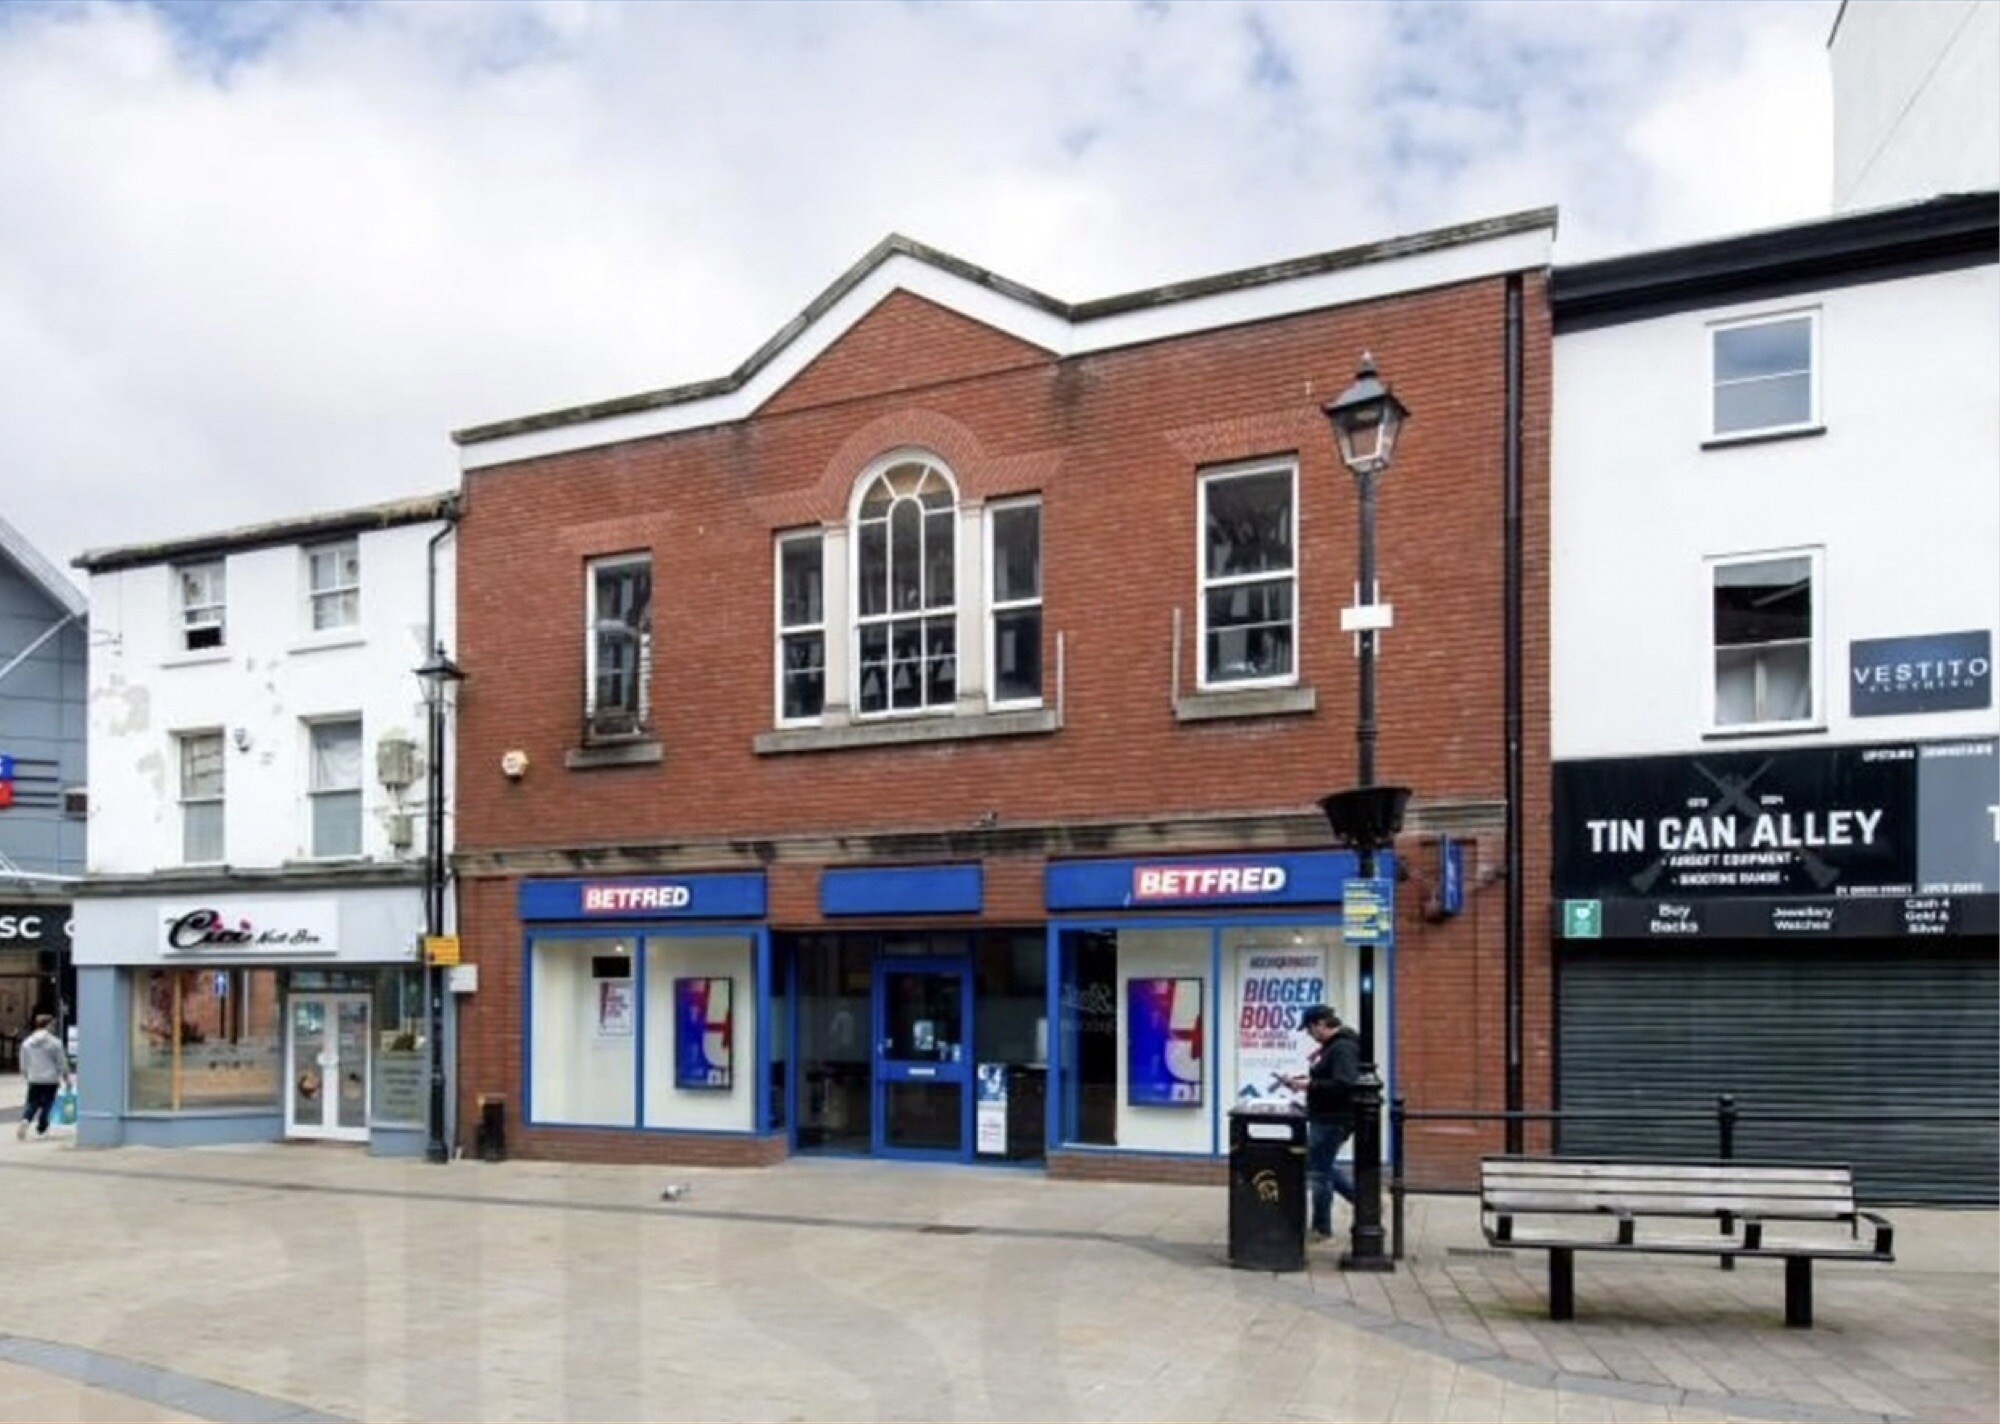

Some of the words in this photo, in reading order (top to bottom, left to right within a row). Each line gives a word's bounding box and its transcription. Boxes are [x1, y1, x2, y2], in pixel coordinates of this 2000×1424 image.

[1853, 658, 1988, 685] VESTITO
[1586, 819, 1645, 852] TIN
[1658, 815, 1736, 850] CAN
[1751, 809, 1883, 848] ALLEY
[1140, 866, 1286, 896] BETFRED
[585, 886, 690, 910] BETFRED
[1658, 903, 1691, 919] Buy
[1243, 977, 1323, 1002] BIGGER
